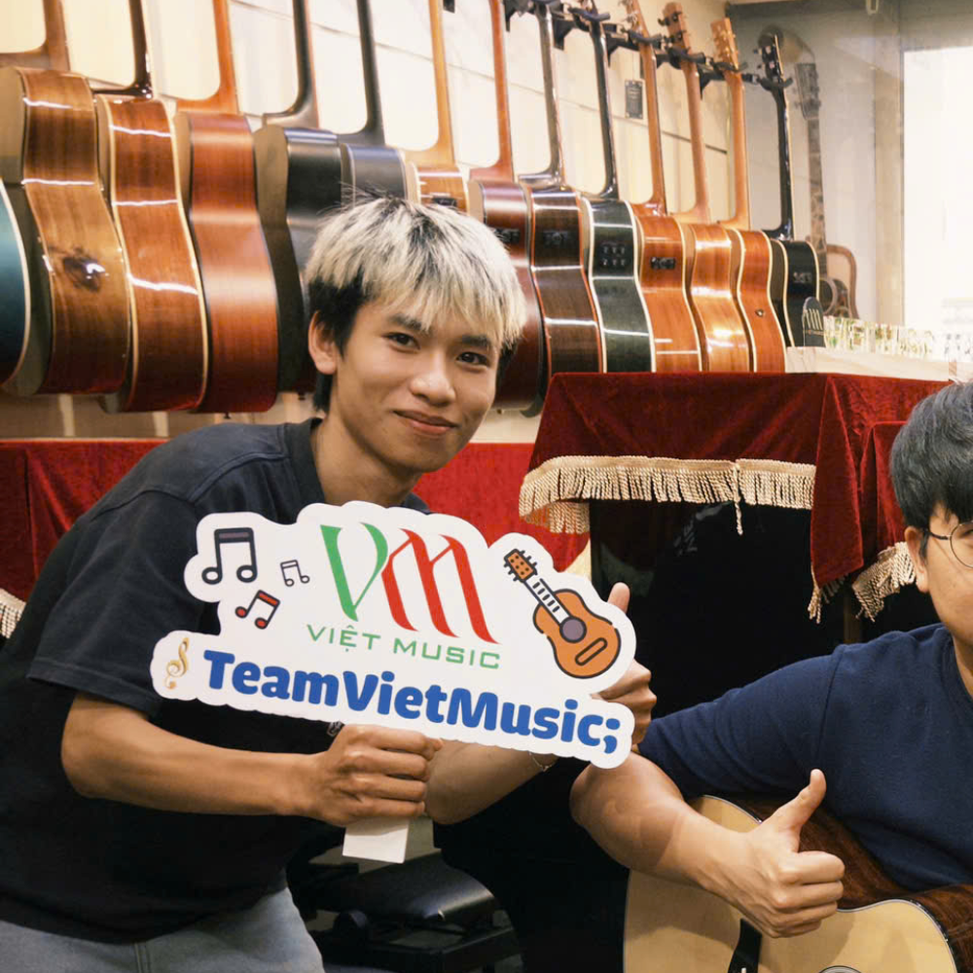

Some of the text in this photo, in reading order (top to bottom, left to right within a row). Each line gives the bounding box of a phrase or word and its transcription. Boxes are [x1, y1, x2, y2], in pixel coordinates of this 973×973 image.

[307, 624, 501, 670] VIỆT MUSIC
[203, 649, 621, 755] TeamVietMusic;
